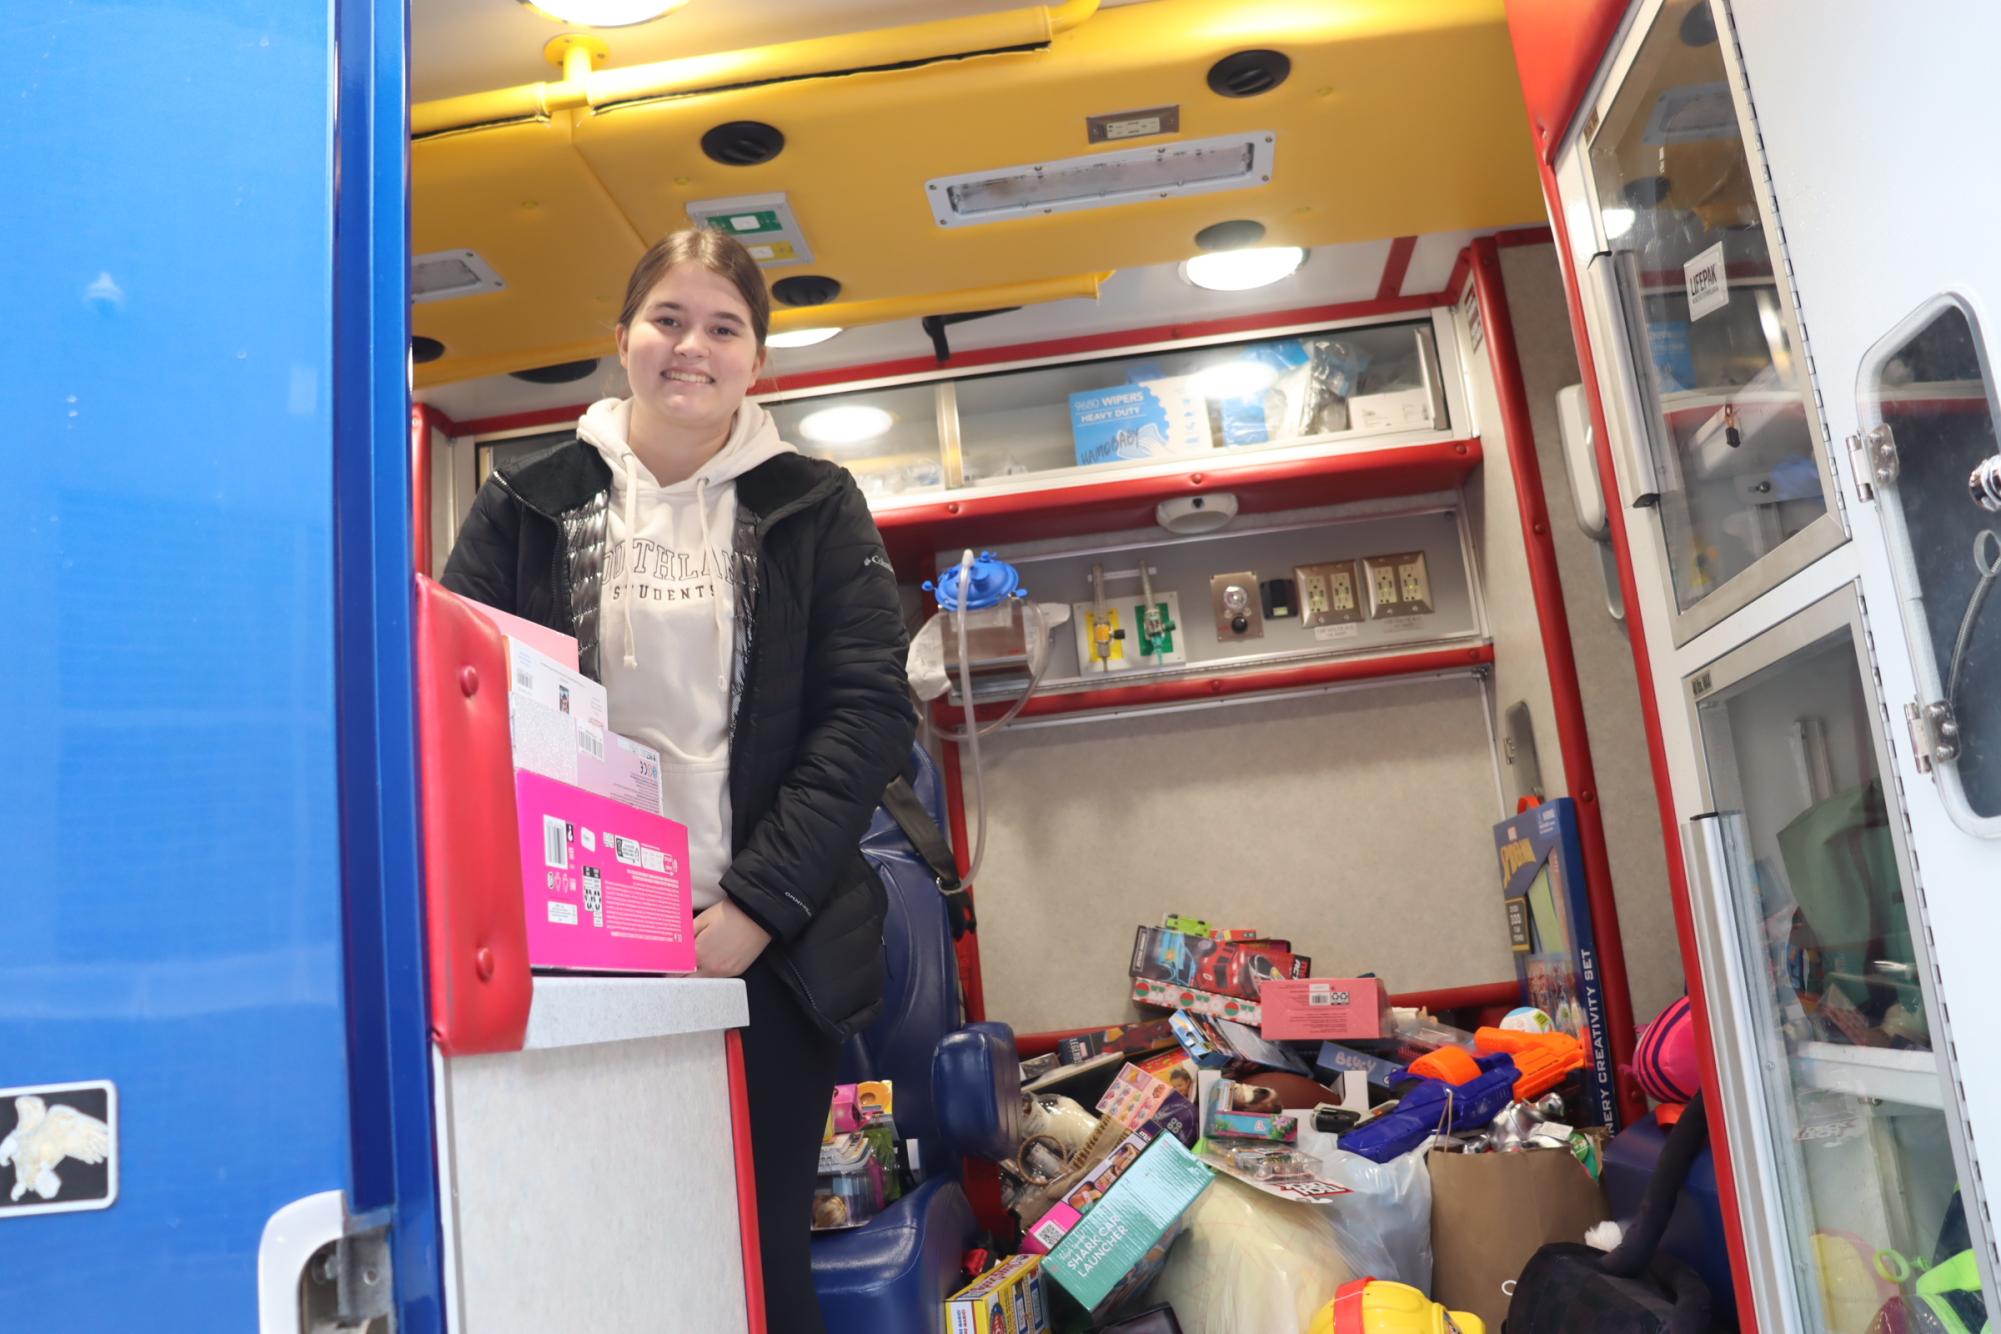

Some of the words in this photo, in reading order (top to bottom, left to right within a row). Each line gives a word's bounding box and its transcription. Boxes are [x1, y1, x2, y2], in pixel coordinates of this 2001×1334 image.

[1690, 264, 1717, 296] LIFEPAK
[1081, 411, 1113, 424] HEAVY
[1114, 407, 1140, 418] DUTY
[1102, 392, 1143, 407] WIPERS
[1580, 948, 1594, 981] SET
[1586, 986, 1608, 1083] CREATIVITY
[1067, 1235, 1100, 1270] SHARK
[1098, 1215, 1120, 1237] CAR
[1077, 1225, 1129, 1277] LAUNCHER
